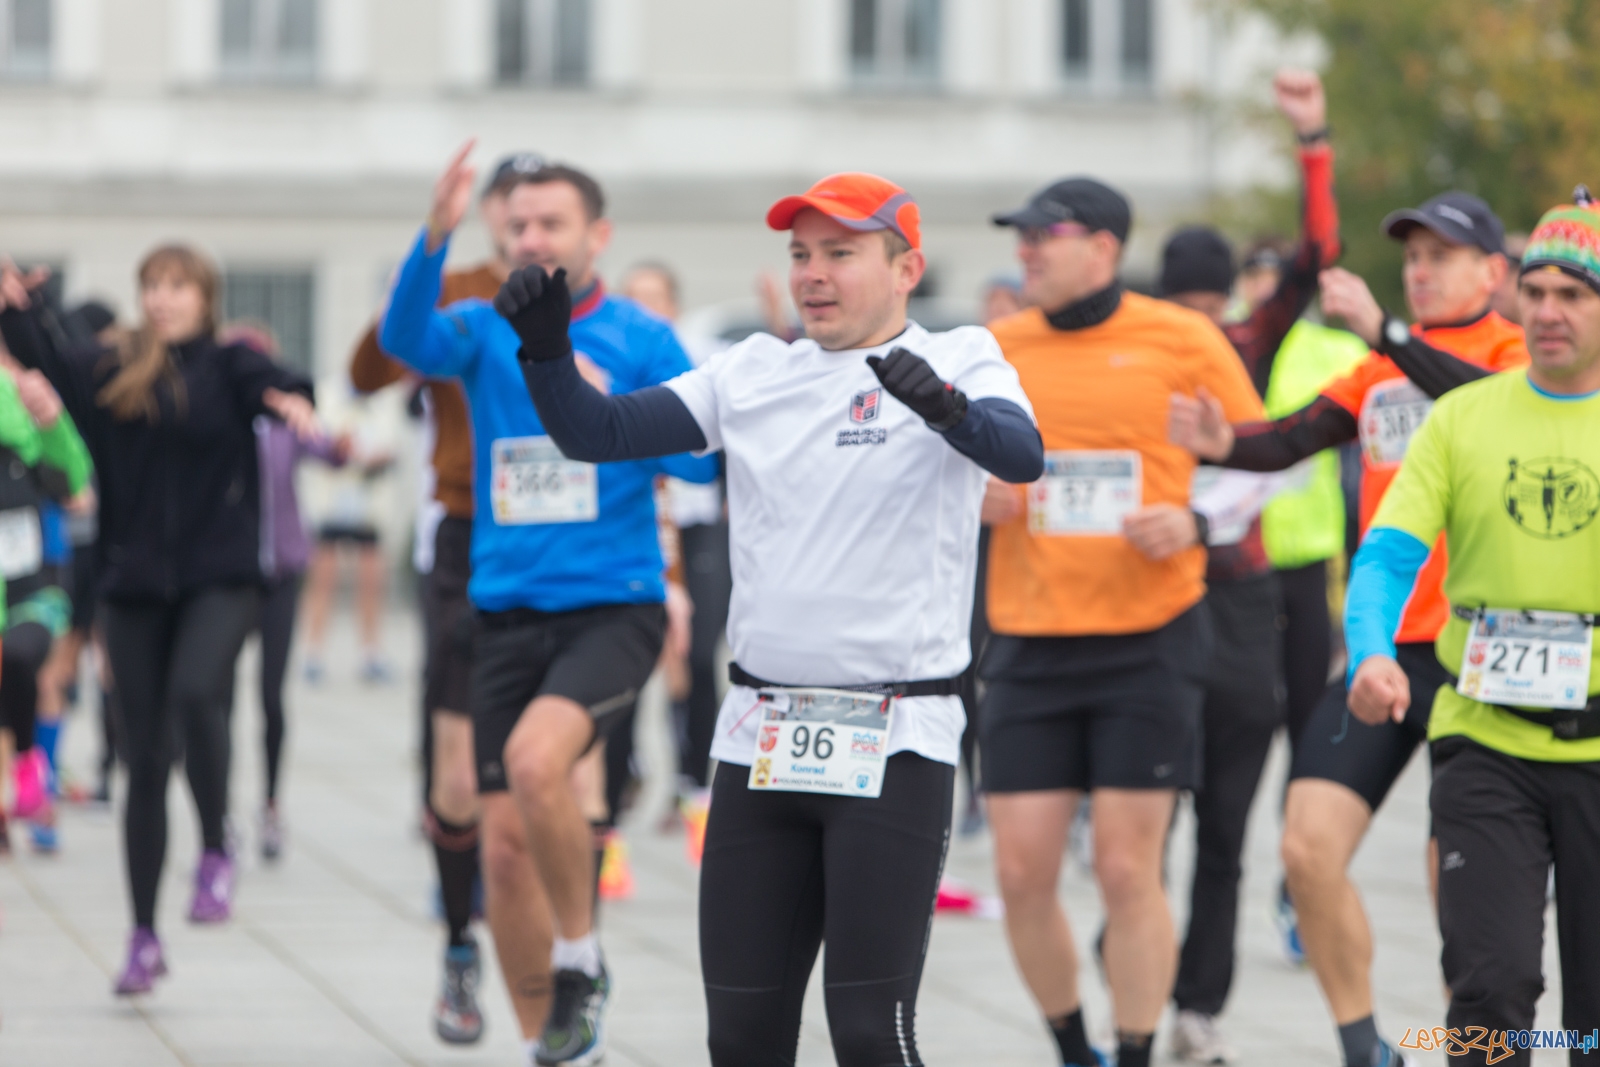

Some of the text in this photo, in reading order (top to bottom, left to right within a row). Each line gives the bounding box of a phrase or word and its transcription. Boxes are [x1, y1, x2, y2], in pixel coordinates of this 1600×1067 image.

[1061, 478, 1099, 510] 57
[1489, 641, 1550, 675] 271
[790, 725, 836, 760] 96
[790, 763, 827, 775] Konrad
